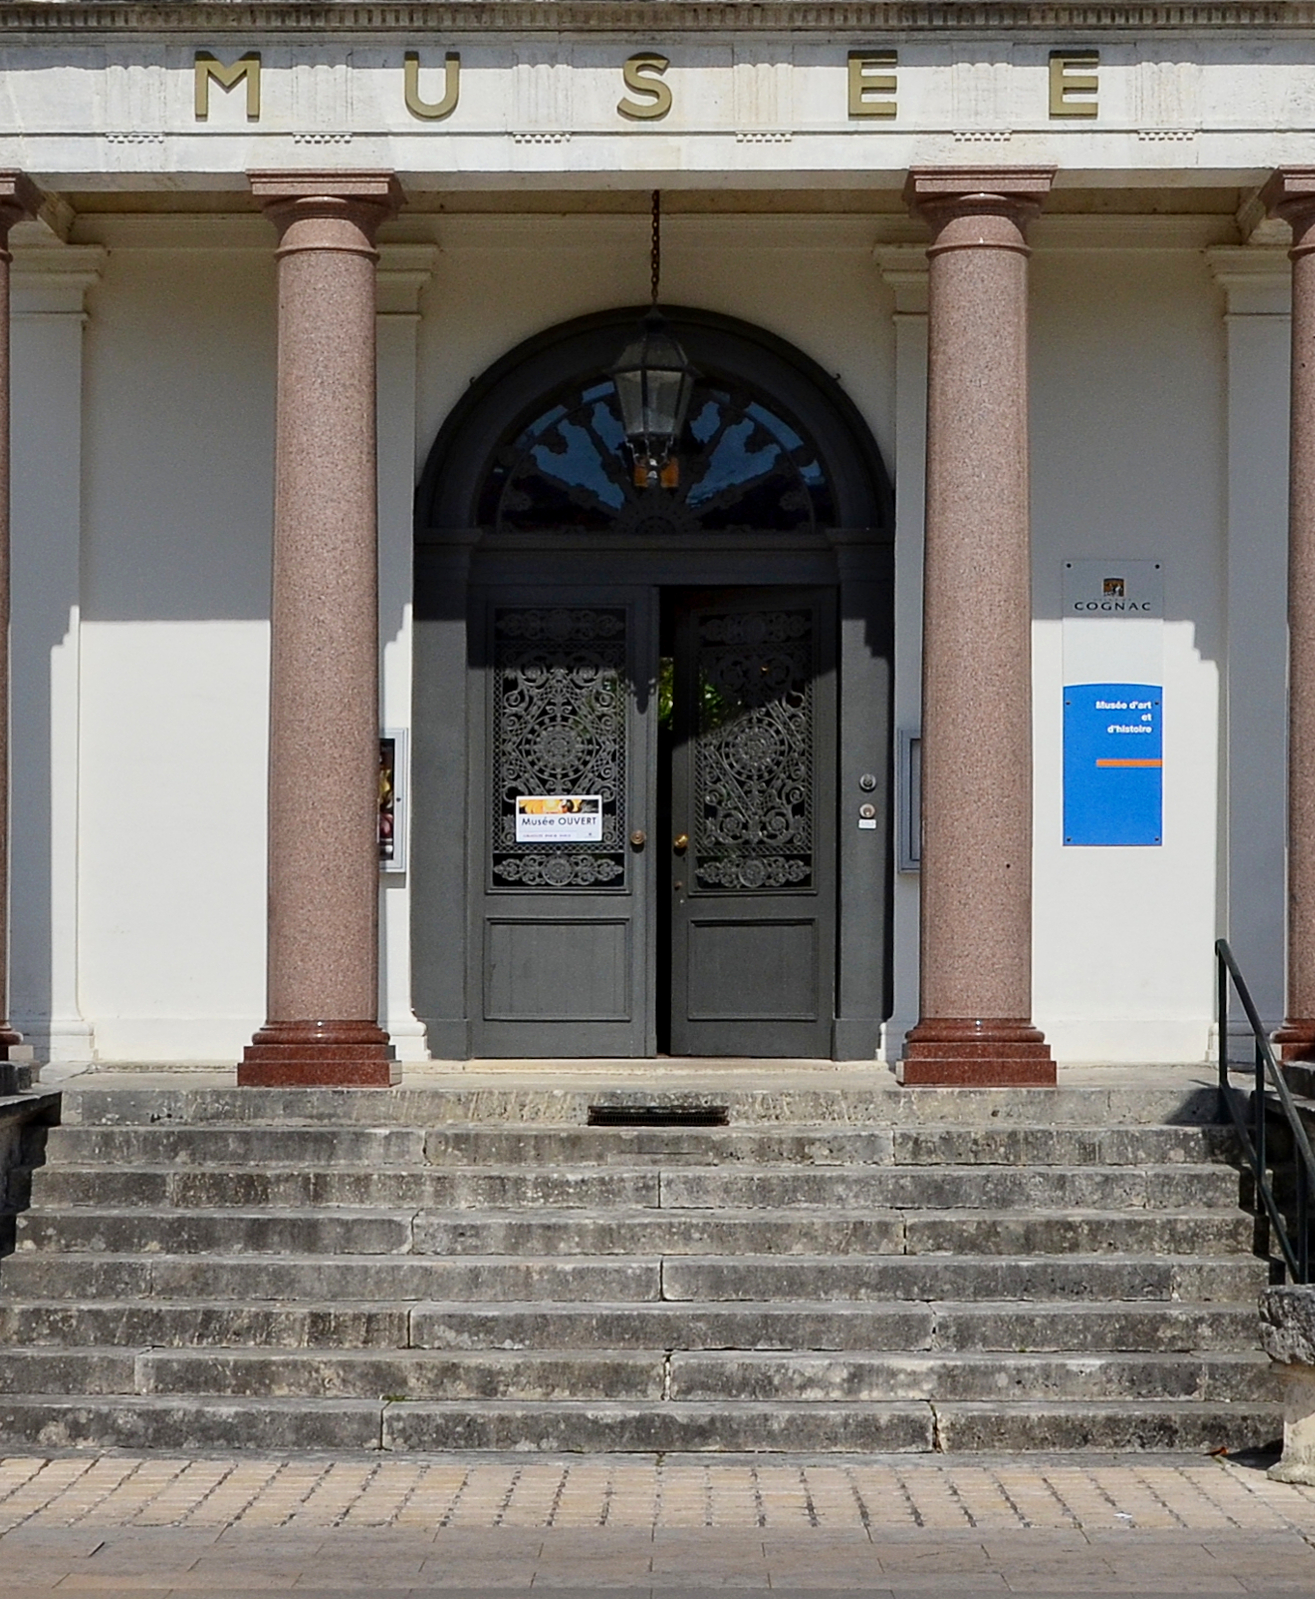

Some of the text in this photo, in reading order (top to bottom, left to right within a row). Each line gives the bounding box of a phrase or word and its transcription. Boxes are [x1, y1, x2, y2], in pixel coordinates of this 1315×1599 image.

[193, 49, 1100, 122] MUSEE
[1074, 602, 1151, 611] COGNAC
[1096, 701, 1152, 709] Musée d'art
[1141, 713, 1152, 721] et
[1107, 725, 1152, 733] d'histoire
[522, 816, 597, 826] Musée OUVERT
